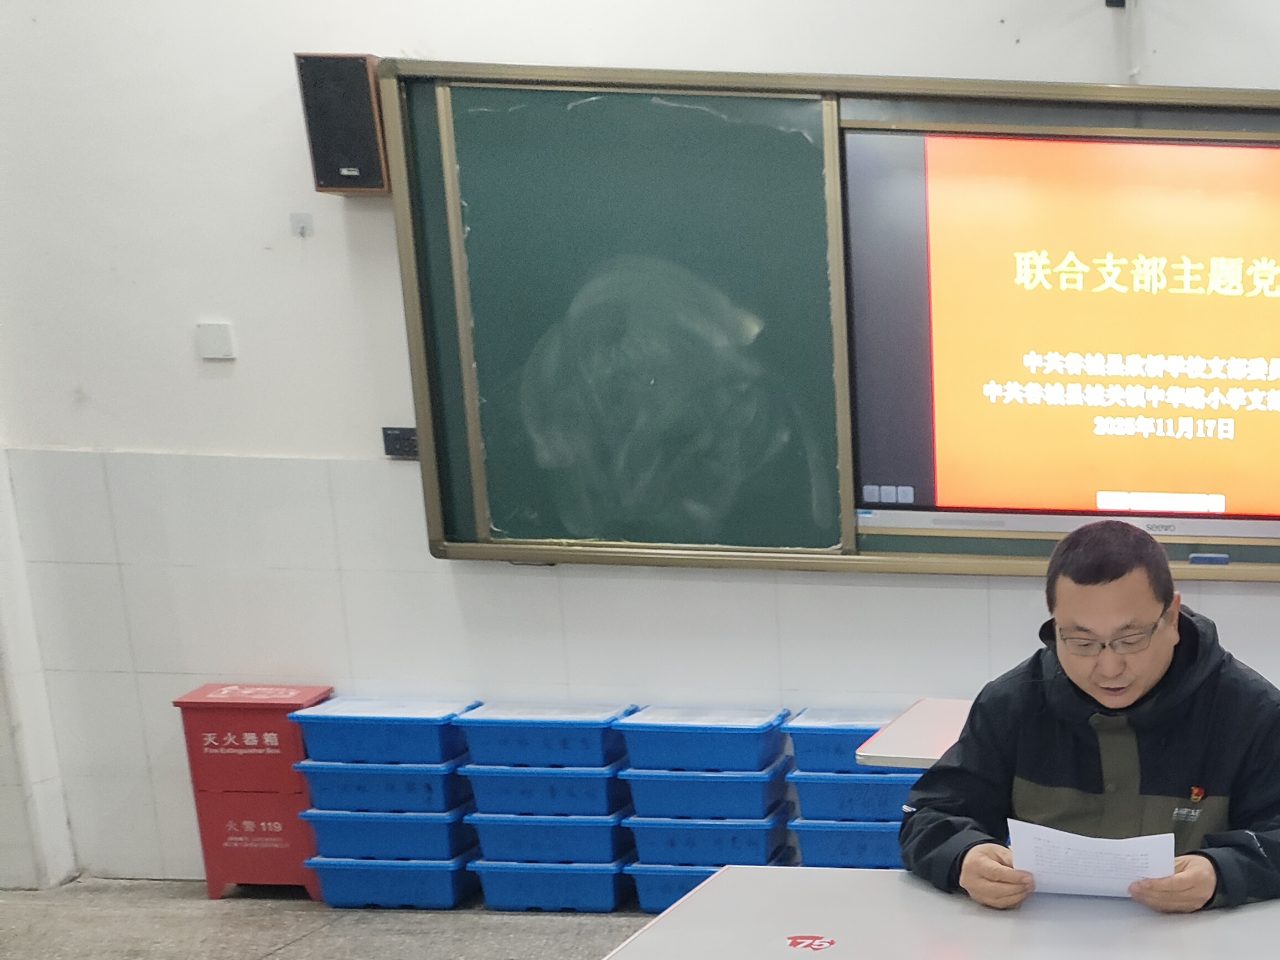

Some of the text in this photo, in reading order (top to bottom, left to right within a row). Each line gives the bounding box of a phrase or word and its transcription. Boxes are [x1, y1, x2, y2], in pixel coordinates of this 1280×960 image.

[203, 732, 280, 746] 灭火器箱
[260, 821, 282, 832] 119
